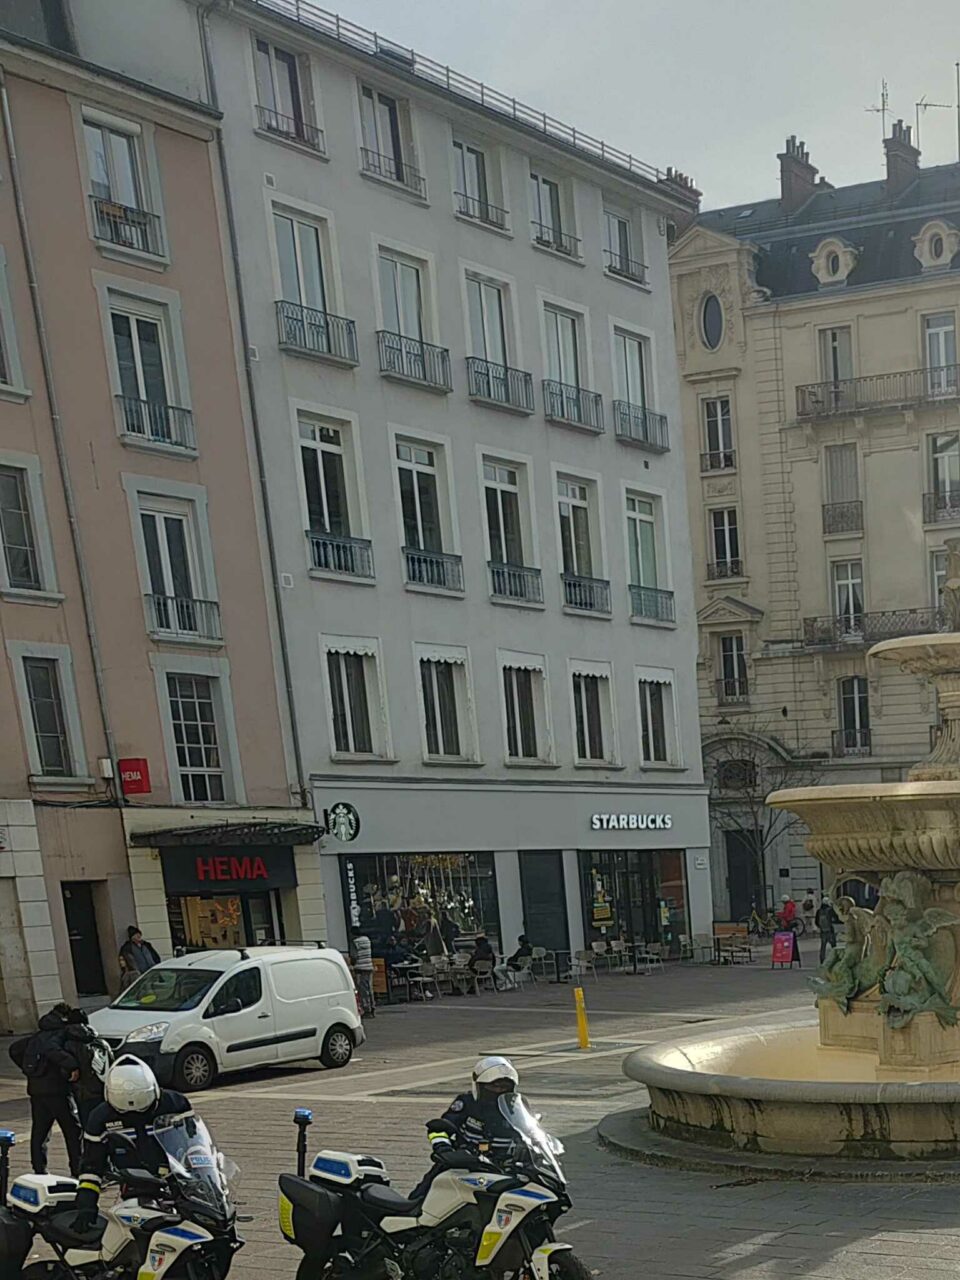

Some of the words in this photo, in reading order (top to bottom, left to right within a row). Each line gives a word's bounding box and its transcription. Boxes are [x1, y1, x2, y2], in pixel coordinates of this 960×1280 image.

[122, 771, 142, 781] HEMA
[592, 814, 673, 829] STARBUCKS
[196, 857, 269, 881] HEMA
